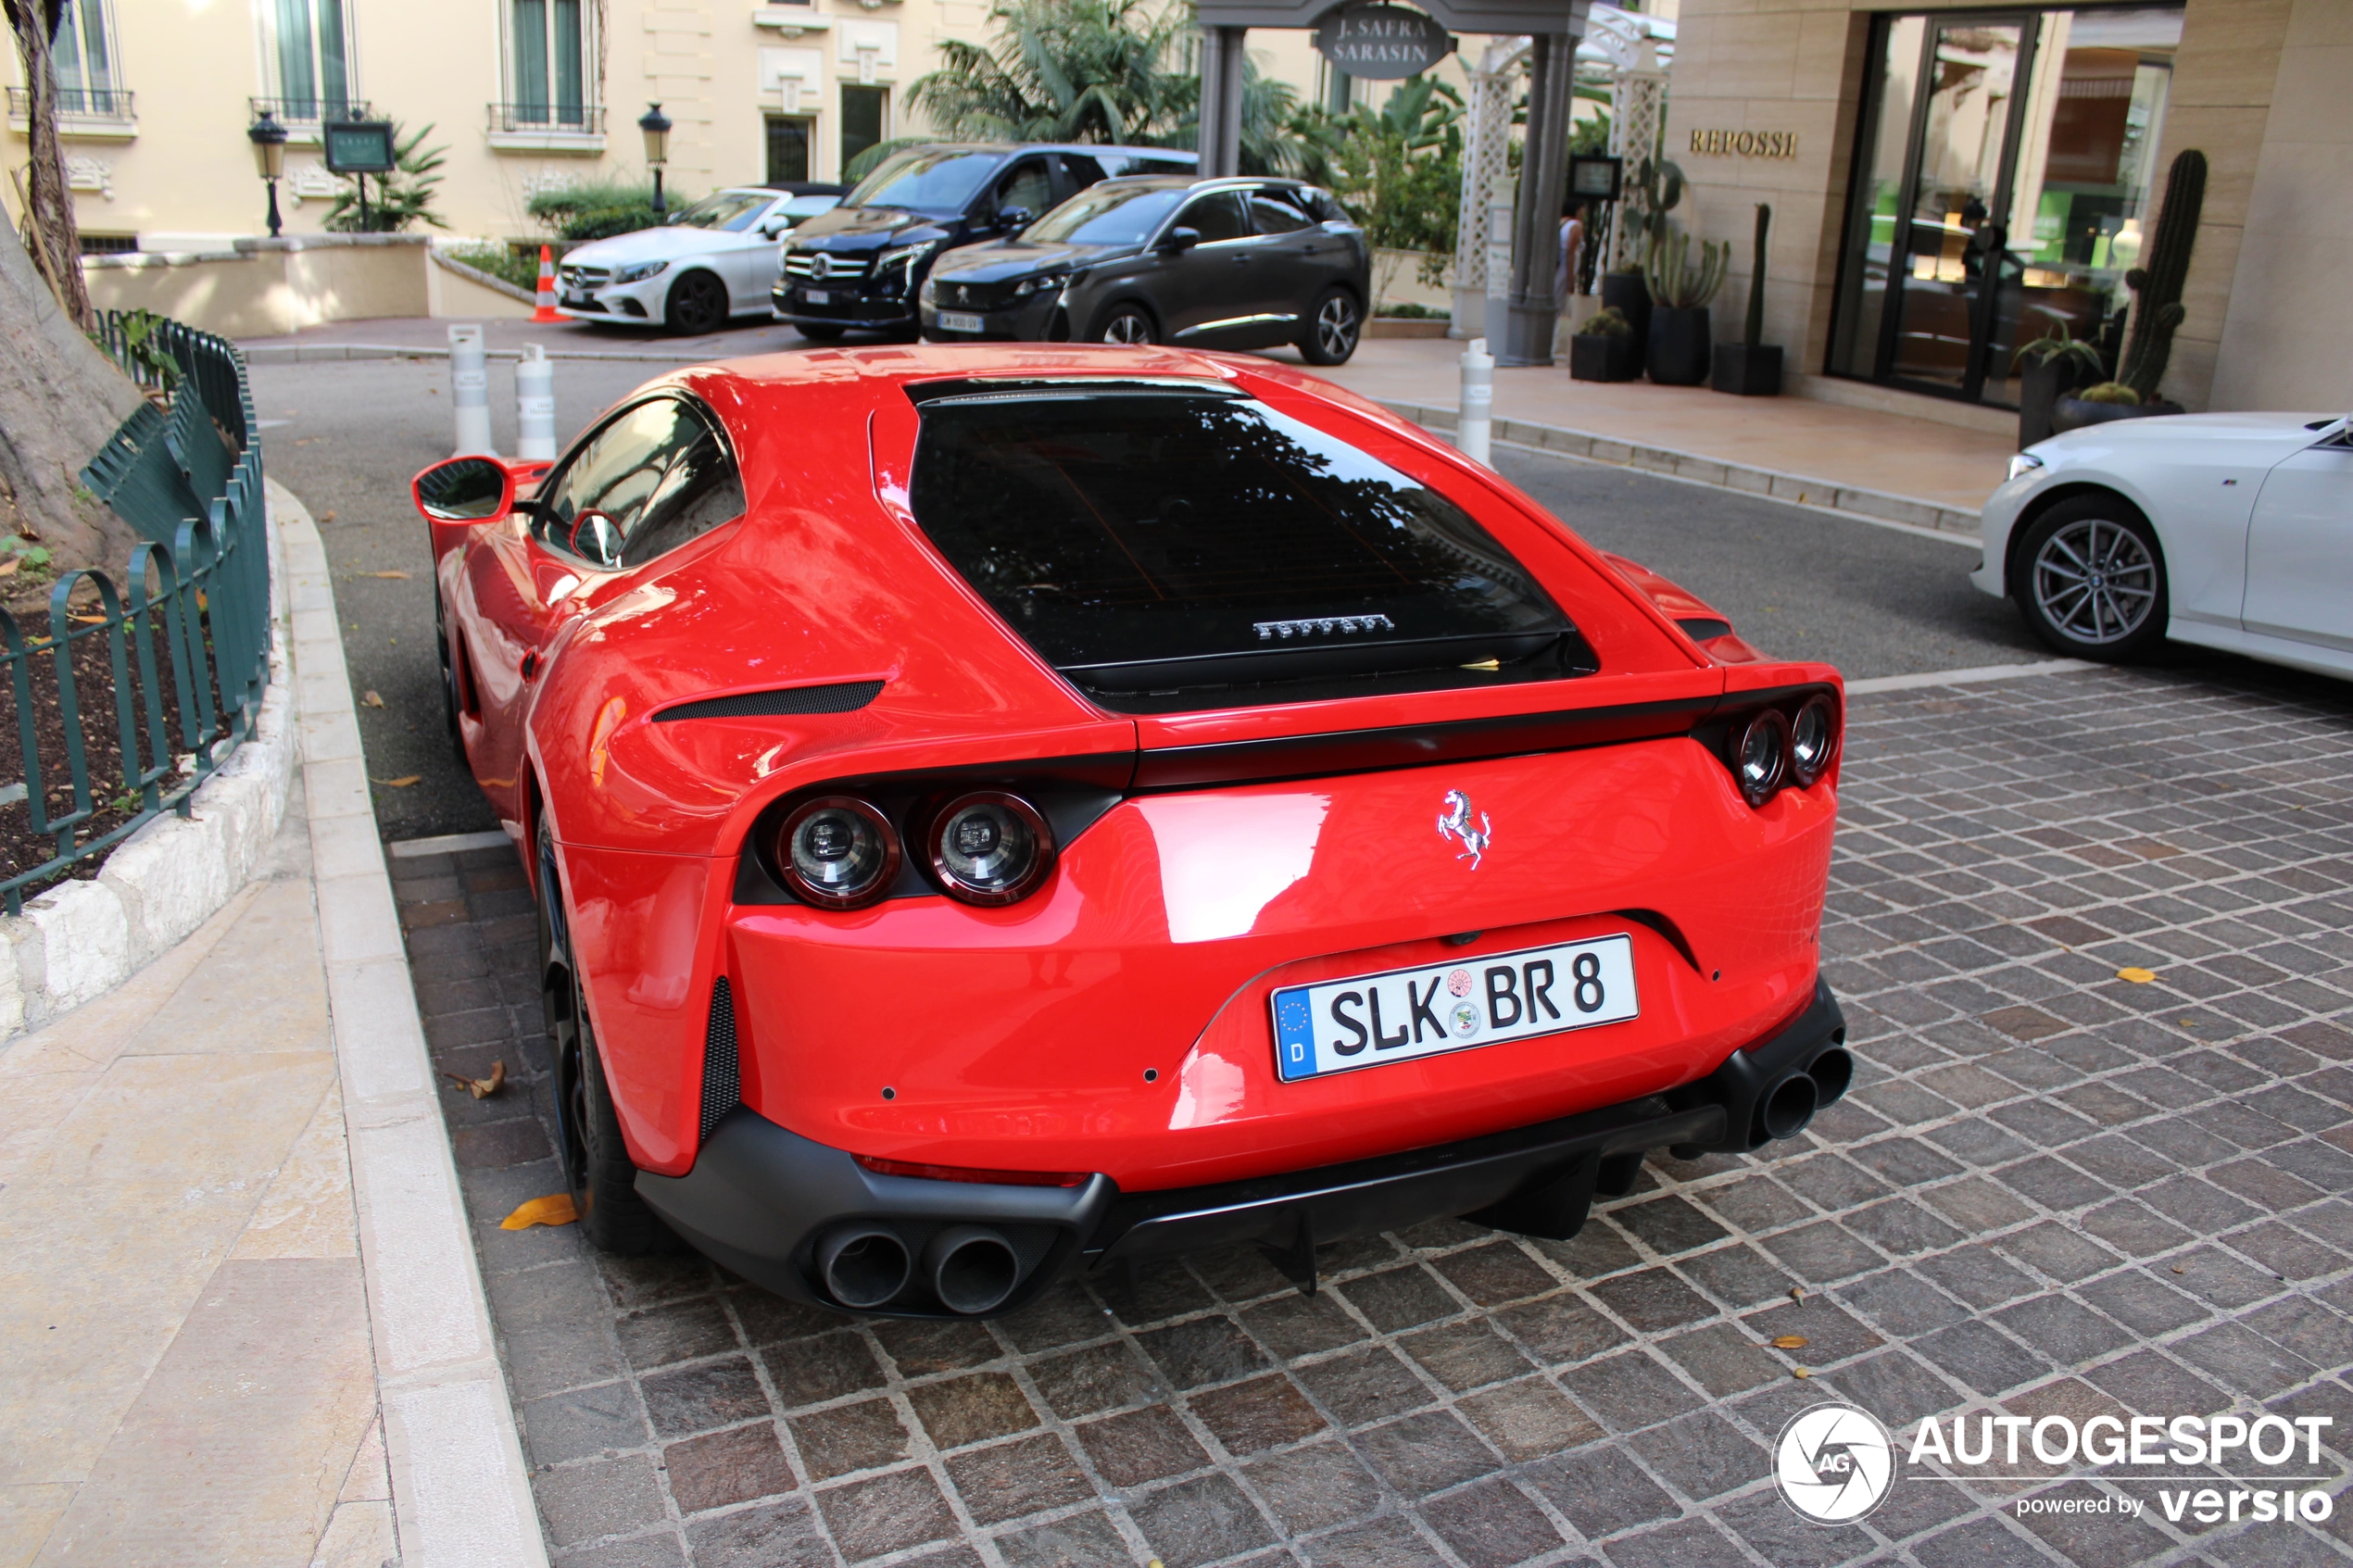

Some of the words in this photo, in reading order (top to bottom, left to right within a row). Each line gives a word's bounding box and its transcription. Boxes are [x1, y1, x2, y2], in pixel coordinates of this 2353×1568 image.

[1337, 19, 1353, 41] J.
[1358, 19, 1428, 38] SAFRA
[1333, 44, 1428, 62] SARASIN
[1691, 129, 1797, 157] REPOSSI
[1330, 975, 1448, 1056] SLK
[1485, 960, 1561, 1030] BR
[1574, 952, 1604, 1013] 8
[1290, 1043, 1304, 1062] D
